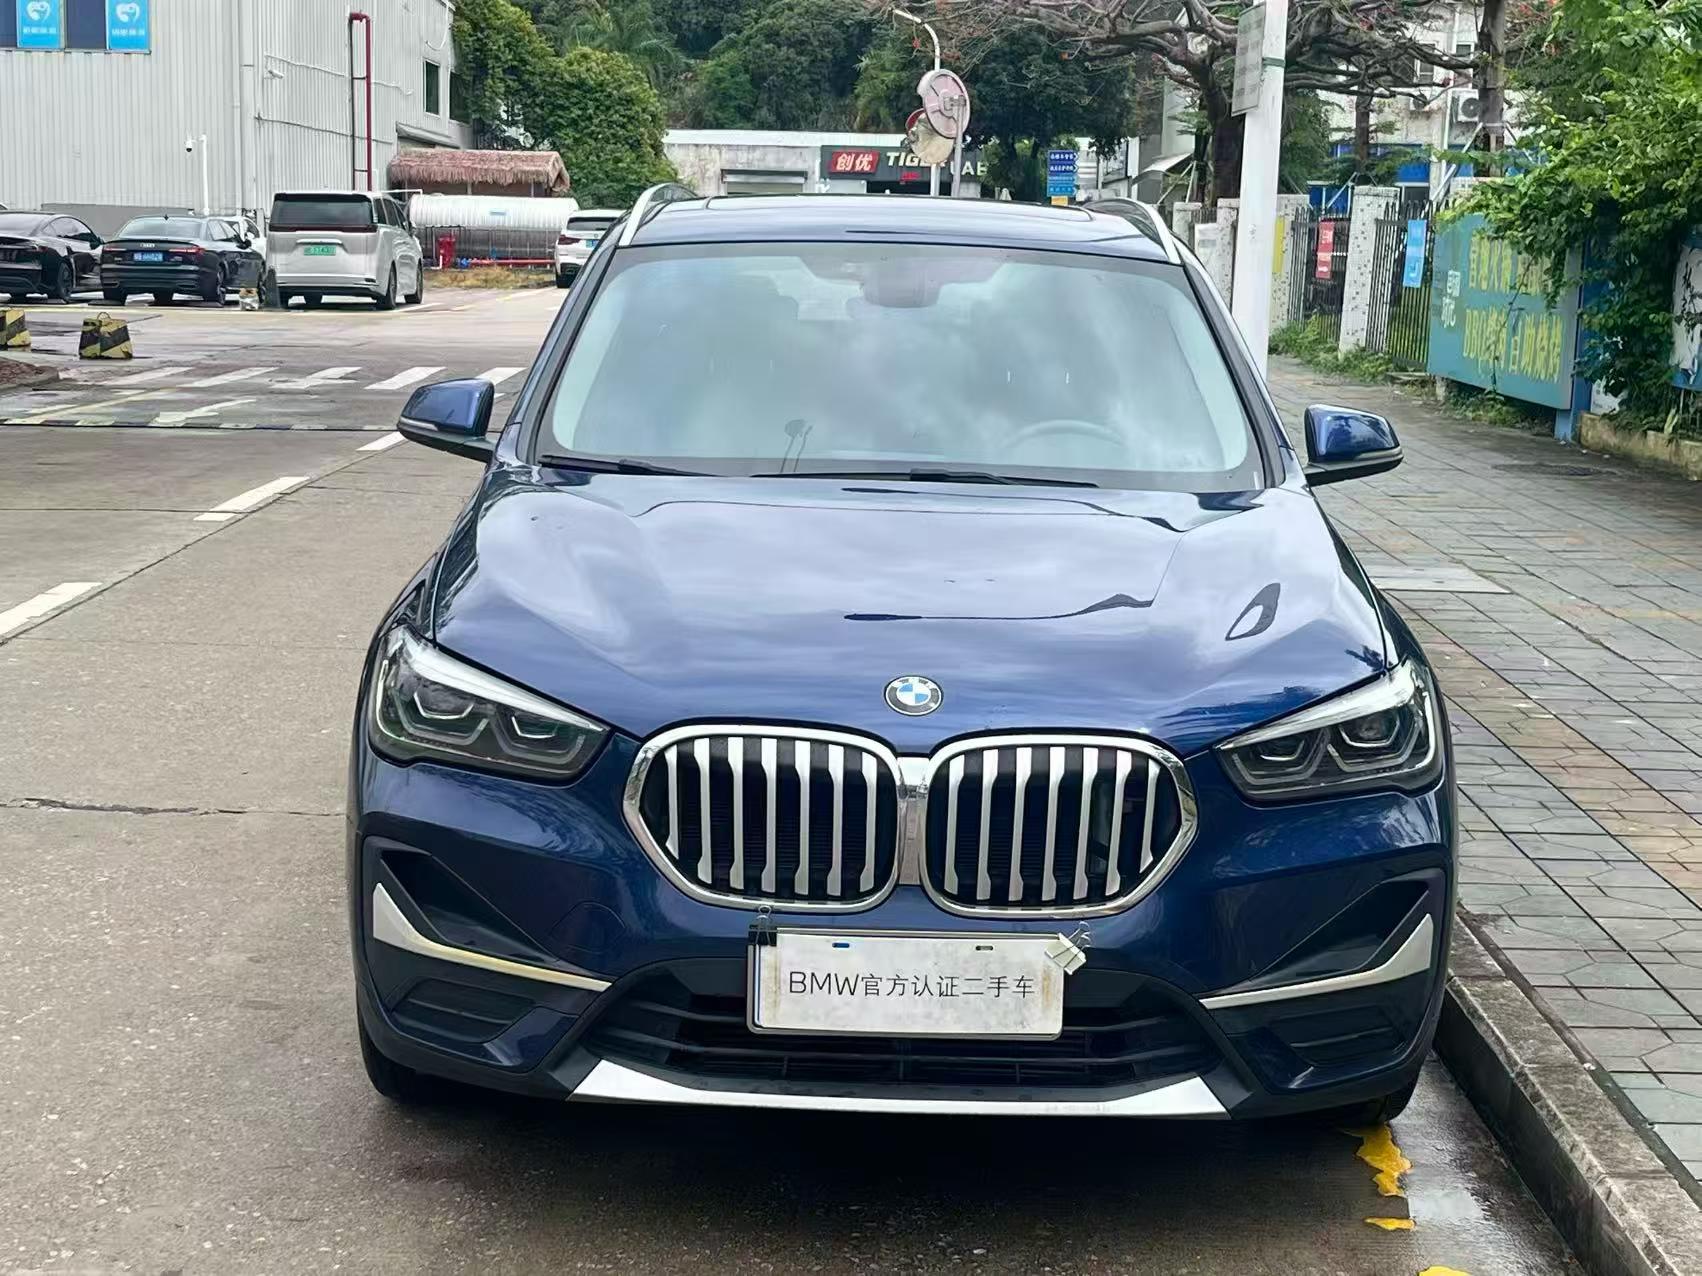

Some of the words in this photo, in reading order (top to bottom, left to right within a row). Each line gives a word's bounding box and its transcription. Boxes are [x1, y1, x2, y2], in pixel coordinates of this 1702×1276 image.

[836, 153, 873, 171] 创优
[886, 152, 946, 167] TIG
[789, 971, 1035, 998] BMW官方认证二手车
